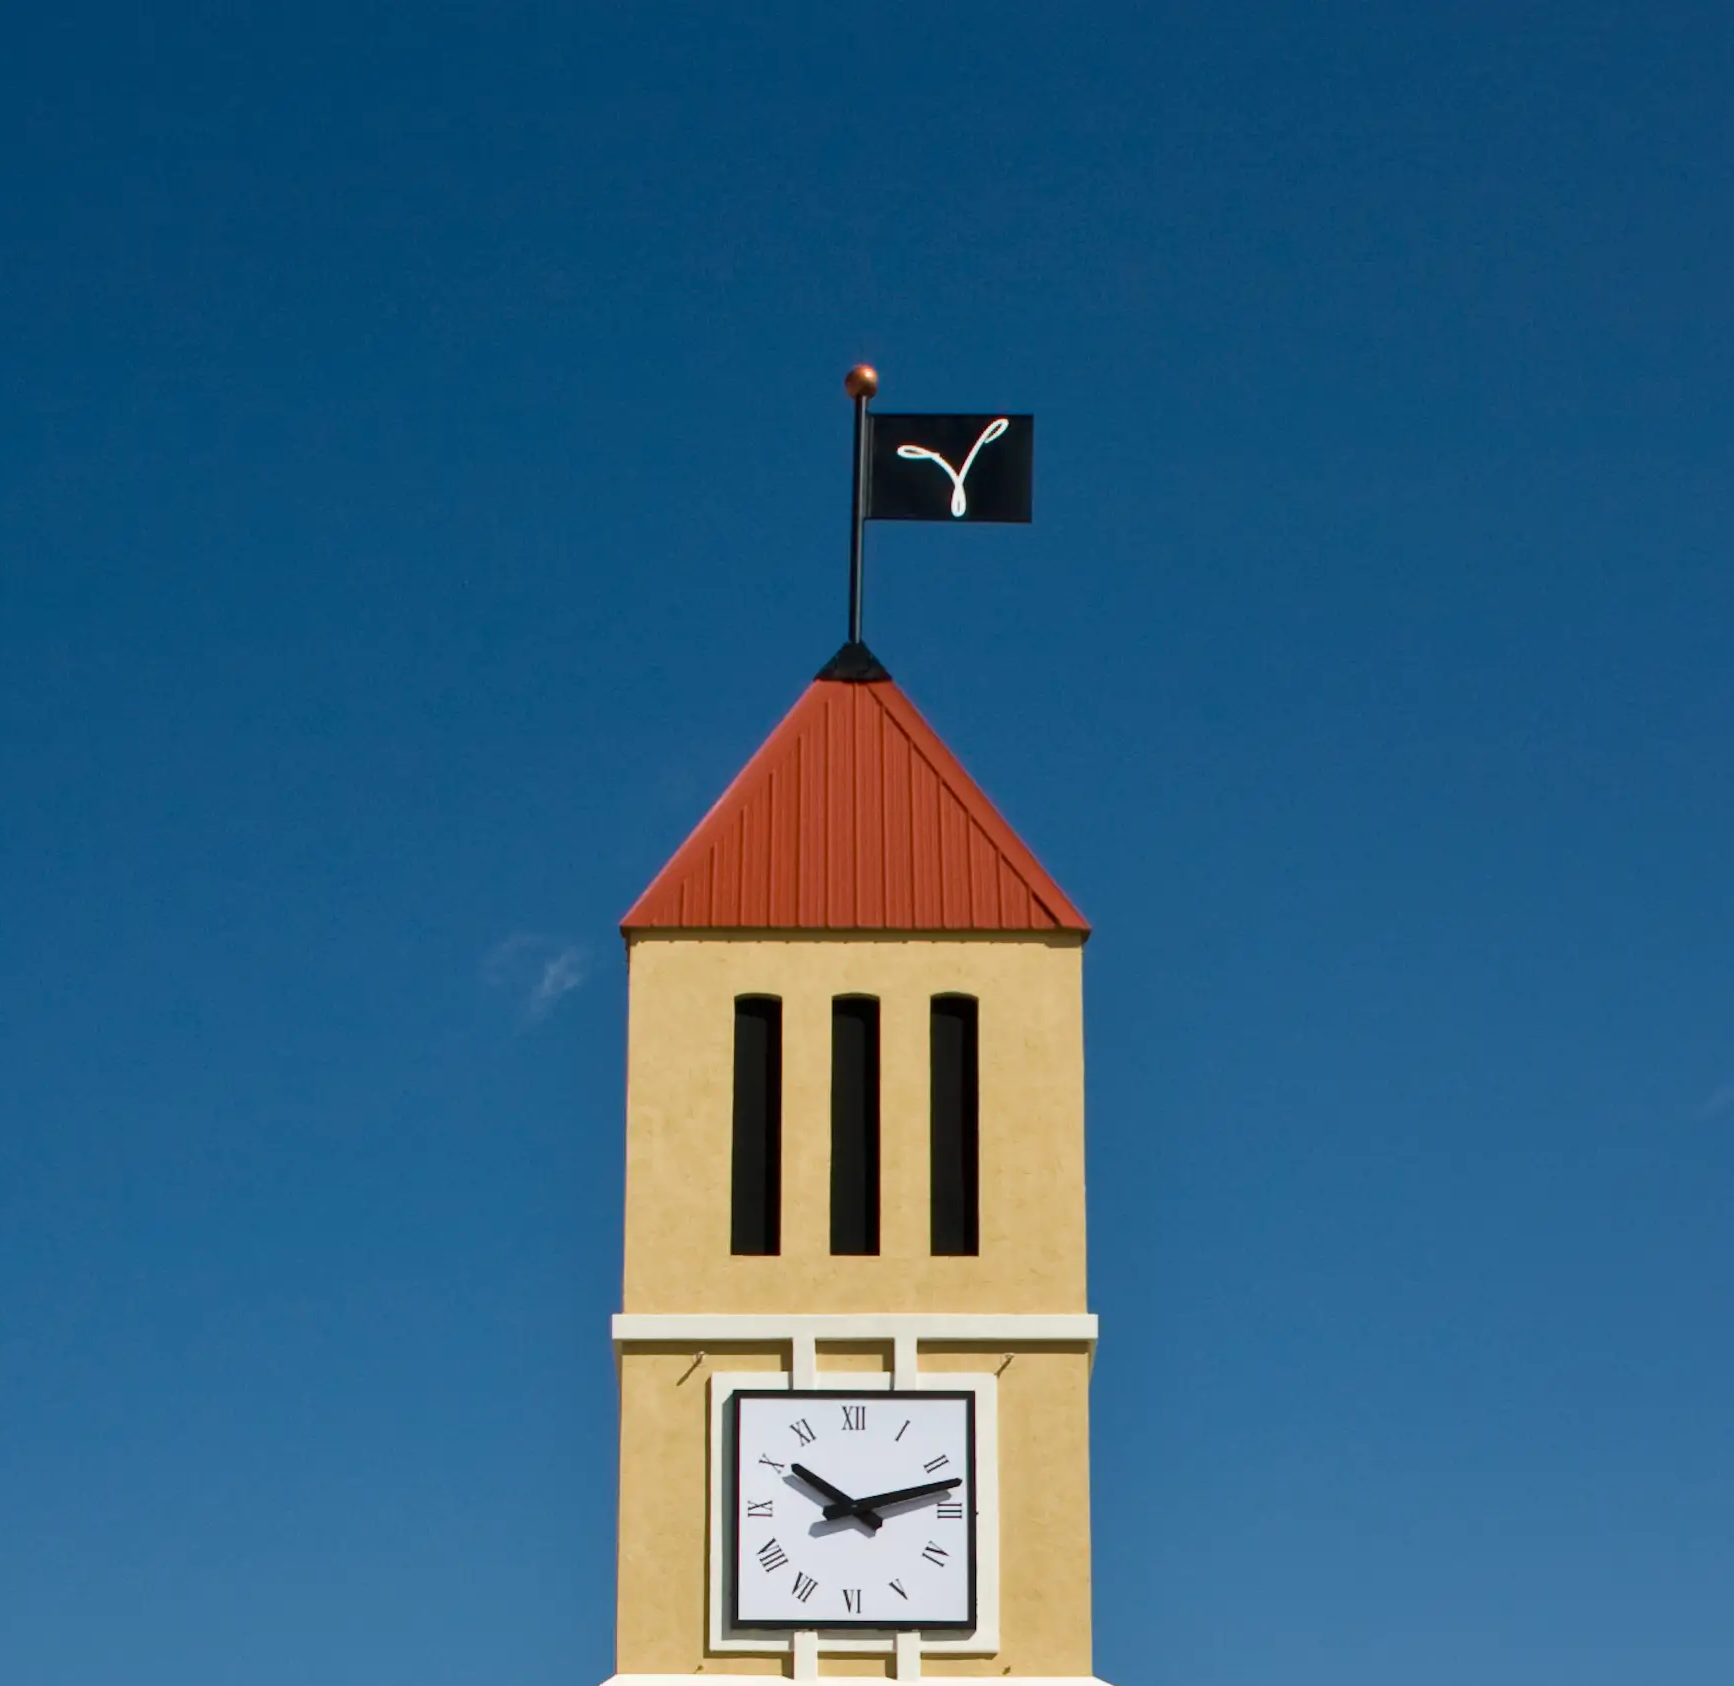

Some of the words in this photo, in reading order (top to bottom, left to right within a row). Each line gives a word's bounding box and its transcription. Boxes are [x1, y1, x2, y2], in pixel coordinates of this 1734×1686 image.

[841, 1405, 866, 1431] XII
[790, 1418, 817, 1447] XI
[894, 1419, 911, 1442] I
[758, 1453, 785, 1474] X
[923, 1454, 949, 1473] II
[747, 1500, 773, 1518] IX
[937, 1502, 963, 1519] III
[756, 1538, 789, 1573] VIII
[922, 1541, 950, 1568] IV
[791, 1571, 818, 1604] VII
[888, 1578, 909, 1601] V
[842, 1588, 862, 1614] VI
